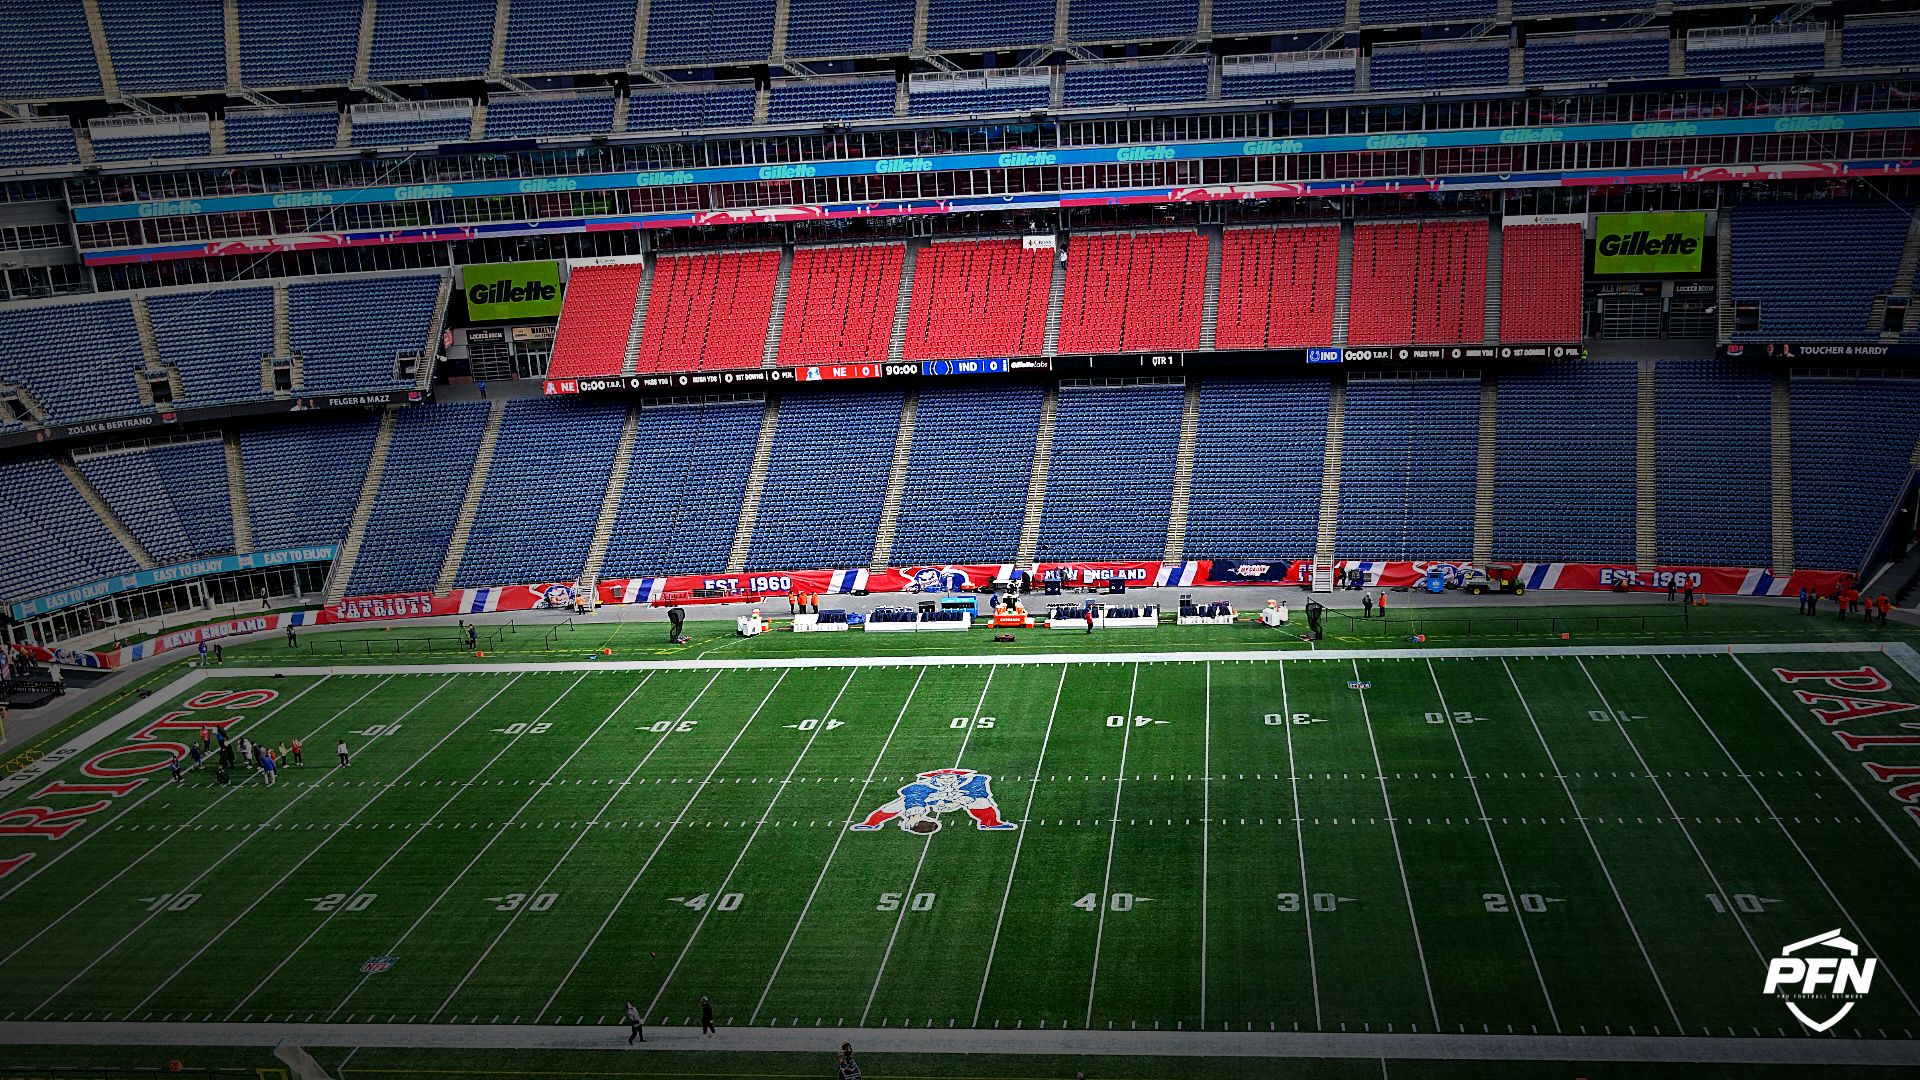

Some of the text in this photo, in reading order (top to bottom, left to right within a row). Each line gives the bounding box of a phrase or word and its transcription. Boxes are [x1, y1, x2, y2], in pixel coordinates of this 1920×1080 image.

[1631, 122, 1697, 138] Gillette
[1775, 116, 1844, 132] Gillette
[1366, 134, 1428, 149] Gillette
[1500, 128, 1563, 143] Gillette
[1117, 145, 1175, 161] Gillette
[1243, 139, 1303, 155] Gillette
[876, 158, 933, 174] Gillette
[999, 151, 1056, 167] Gillette
[636, 171, 694, 187] Gillette
[759, 164, 816, 180] Gillette
[395, 184, 454, 200] Gillette
[519, 178, 577, 193] Gillette
[273, 192, 333, 208] Gillette
[138, 201, 202, 217] Gillette
[1599, 231, 1698, 256] Gillette
[469, 280, 556, 305] Gillette
[1320, 351, 1338, 360] IND
[1345, 350, 1372, 360] 0:00
[1399, 349, 1408, 359] 0
[1451, 348, 1461, 359] 0
[1501, 347, 1512, 358] 0
[1553, 346, 1563, 357] 0
[1799, 346, 1889, 355] TOUCHER & HARDY
[1152, 356, 1173, 366] QTR 1
[560, 381, 575, 392] NE
[580, 380, 606, 391] 0:00
[630, 378, 640, 388] 0
[678, 375, 688, 386] 0
[724, 373, 733, 383] 0
[771, 370, 780, 380] 0
[832, 367, 848, 377] NE
[861, 366, 871, 377] 0
[885, 364, 918, 376] 90:00
[958, 361, 978, 372] IND
[989, 360, 998, 371] 0
[329, 394, 391, 406] FELGER & MAZZ
[67, 423, 98, 435] ZOLAK
[98, 423, 106, 432] &
[106, 416, 153, 431] BERTRAND
[263, 552, 288, 564] EASY
[289, 550, 302, 561] TO
[303, 548, 332, 560] ENJOY
[153, 568, 178, 582] EASY
[178, 566, 192, 577] TO
[192, 559, 223, 575] ENJOY
[70, 589, 82, 601] TO
[83, 581, 109, 597] ENJOY
[749, 576, 792, 592] 1960
[160, 618, 268, 649] NEW ENGLAND
[796, 718, 845, 731] 40
[950, 717, 996, 729] 50
[1106, 715, 1153, 728] 40
[1264, 713, 1311, 726] 30
[1424, 711, 1475, 724] 20
[503, 722, 553, 735] 20
[649, 720, 698, 733] 30
[146, 893, 201, 911] 10
[313, 893, 378, 911] 20
[495, 893, 559, 911] 30
[683, 893, 745, 911] 40
[876, 893, 936, 911] 50
[1073, 893, 1134, 911] 40
[1277, 893, 1337, 912] 30
[1482, 893, 1548, 913] 20
[1705, 893, 1766, 913] 10
